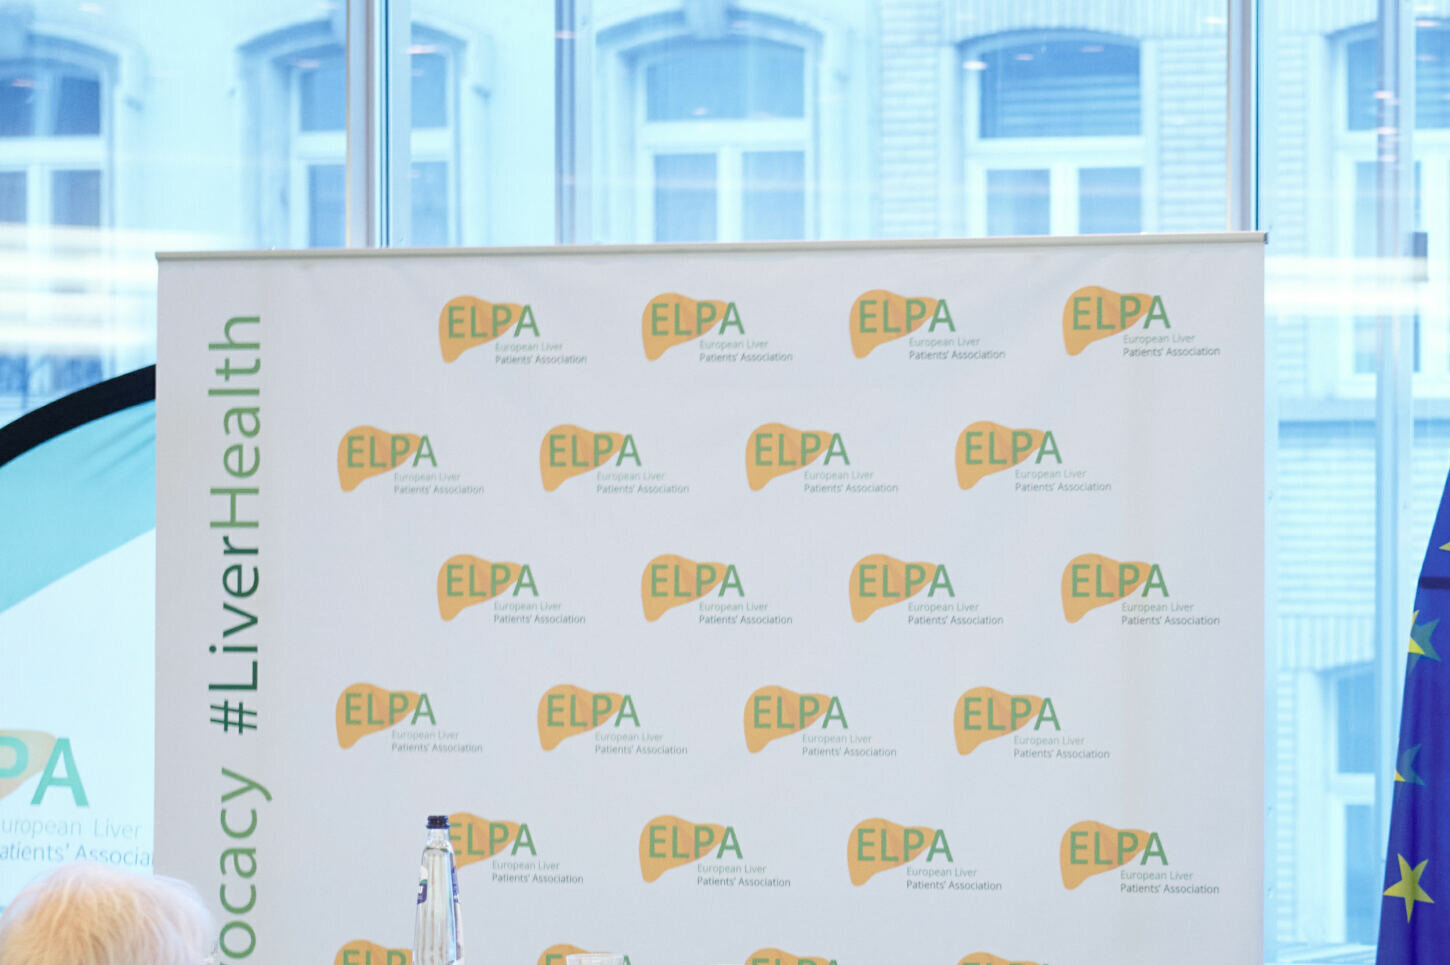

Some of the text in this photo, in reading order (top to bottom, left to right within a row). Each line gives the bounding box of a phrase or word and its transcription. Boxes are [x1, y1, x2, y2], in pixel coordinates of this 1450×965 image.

[448, 304, 541, 339] ELPA
[652, 302, 745, 337] ELPA
[860, 299, 956, 333] ELPA
[1073, 296, 1172, 330] ELPA
[496, 343, 538, 352] European
[1123, 334, 1196, 345] European Liver
[1123, 347, 1220, 357] Patients' Association
[496, 354, 587, 364] Patients' Association
[347, 435, 439, 468] ELPA
[549, 434, 643, 468] ELPA
[756, 432, 851, 466] ELPA
[966, 430, 1062, 465] ELPA
[597, 472, 664, 482] European Liver
[597, 484, 689, 493] Patients' Association
[208, 315, 261, 734] #LiverHealth
[447, 564, 540, 598] ELPA
[651, 564, 745, 598] ELPA
[859, 564, 956, 599] ELPA
[1071, 563, 1169, 599] ELPA
[908, 602, 979, 612] European Liver
[908, 615, 1004, 625] Patients' Association
[345, 693, 437, 726] ELPA
[547, 695, 641, 728] ELPA
[754, 696, 849, 729] ELPA
[964, 697, 1062, 732] ELPA
[392, 730, 458, 741] European Liver
[392, 742, 482, 752] Patients' Association
[1014, 735, 1084, 746] European Liver
[1014, 748, 1110, 759] Patients' Association
[94, 818, 143, 839] Liver
[446, 823, 537, 857] ELPA
[649, 826, 744, 860] ELPA
[76, 845, 154, 866] Associa
[857, 829, 953, 863] ELPA
[1070, 832, 1169, 865] ELPA
[697, 876, 790, 887] Patients' Association
[698, 864, 767, 875] European Liver
[1121, 870, 1192, 882] European Liver
[1120, 884, 1220, 894] Patients' Association
